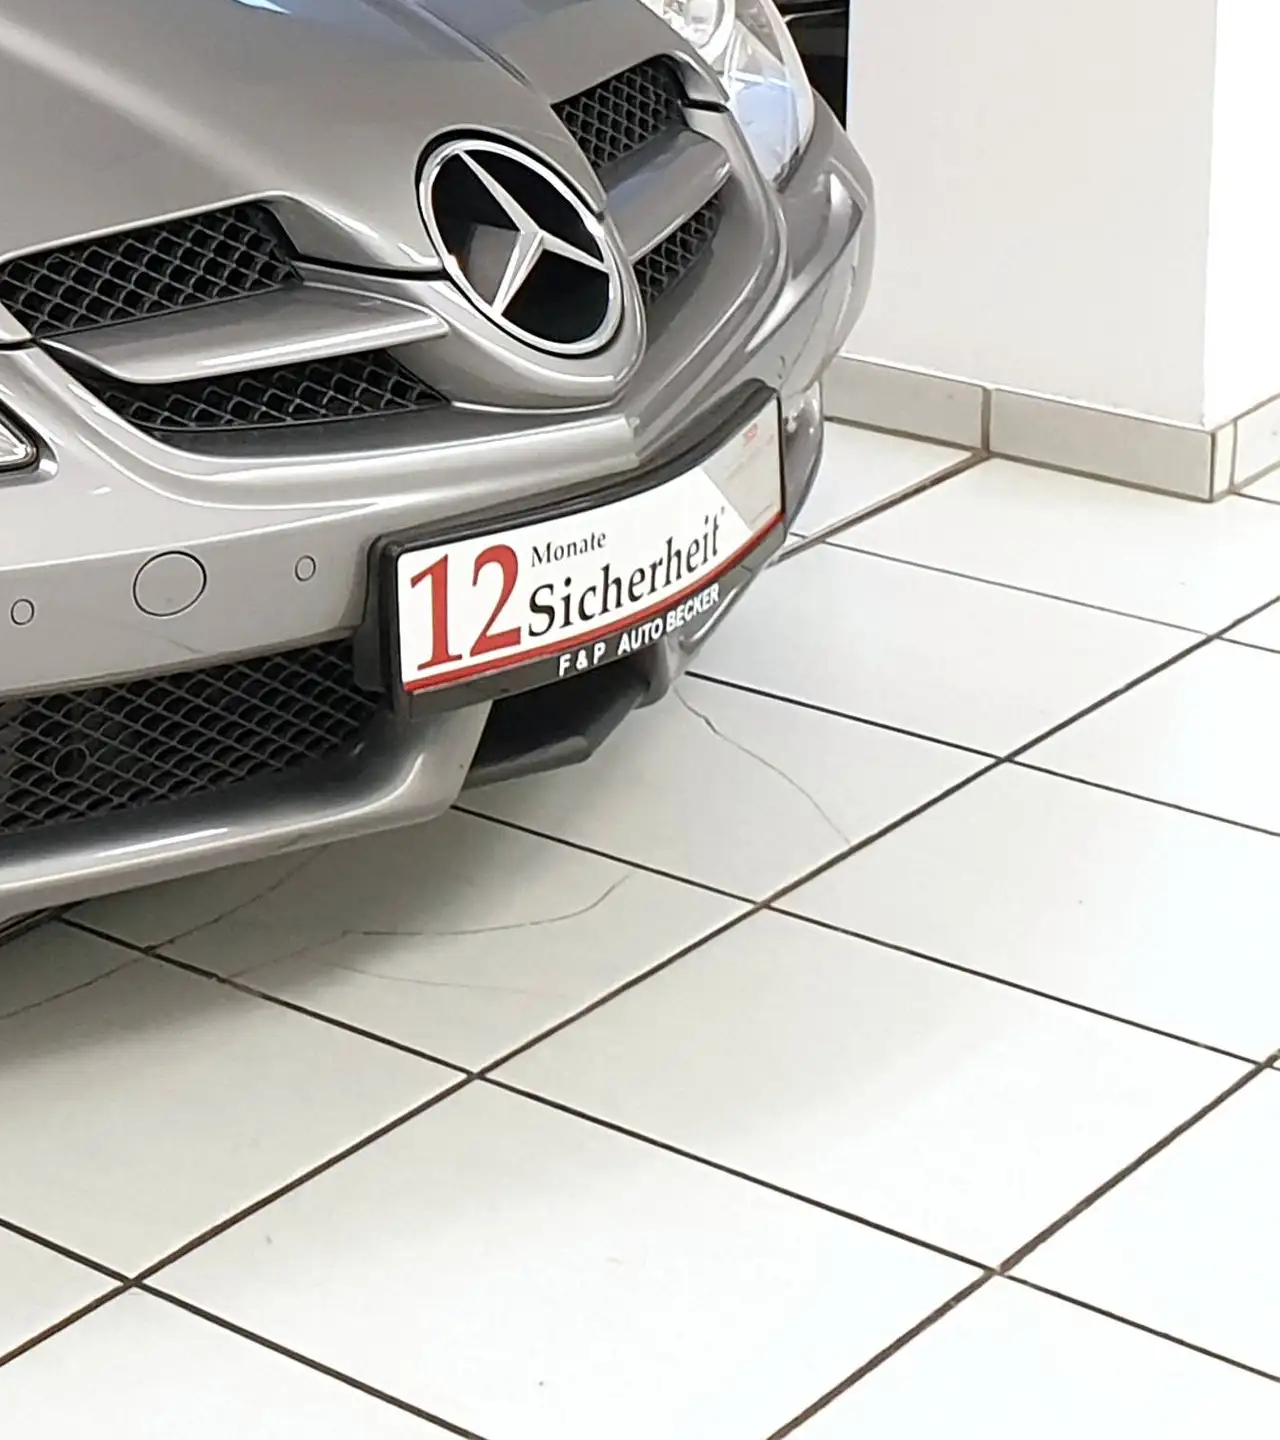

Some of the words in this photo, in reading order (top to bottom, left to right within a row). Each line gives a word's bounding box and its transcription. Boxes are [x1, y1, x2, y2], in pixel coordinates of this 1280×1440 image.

[530, 529, 607, 568] Monate
[410, 543, 522, 671] 12
[558, 653, 572, 677] F
[575, 649, 588, 671] &
[593, 642, 606, 665] P
[616, 618, 664, 656] AUTO
[665, 582, 720, 634] BECKER
